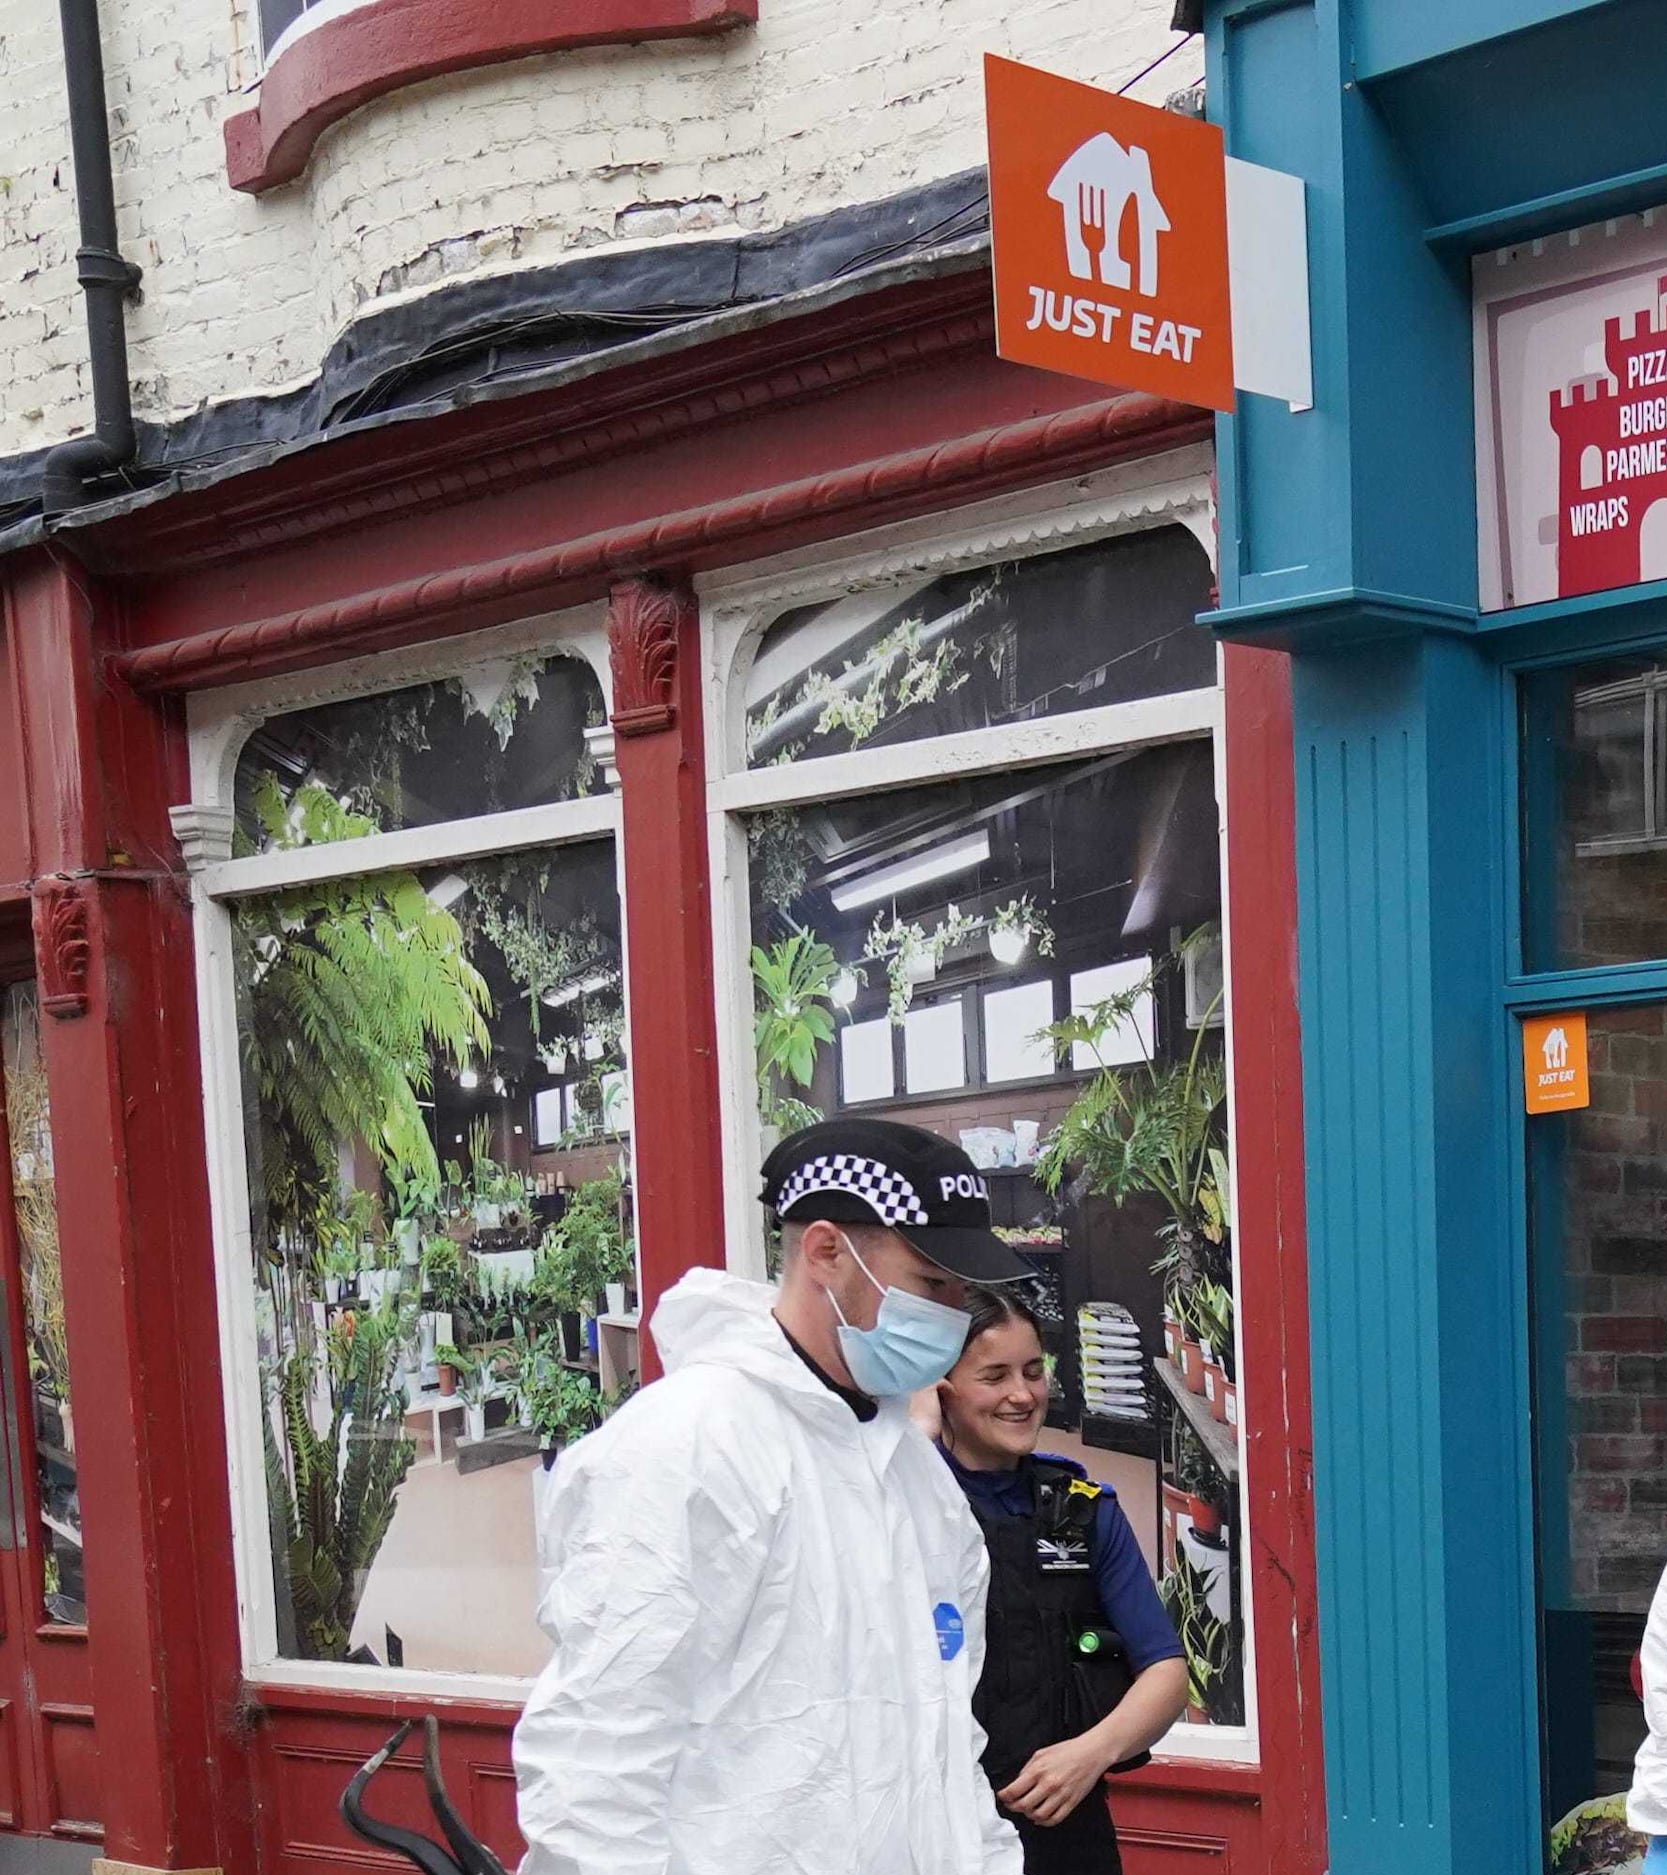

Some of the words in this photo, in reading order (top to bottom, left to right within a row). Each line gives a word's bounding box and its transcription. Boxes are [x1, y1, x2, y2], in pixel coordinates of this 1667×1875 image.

[1026, 285, 1121, 344] JUST
[1129, 311, 1202, 364] EAT
[1570, 497, 1629, 537] WRAPS
[1538, 1071, 1559, 1087] JUST
[1559, 1070, 1576, 1082] EAT
[939, 1172, 989, 1202] POLI
